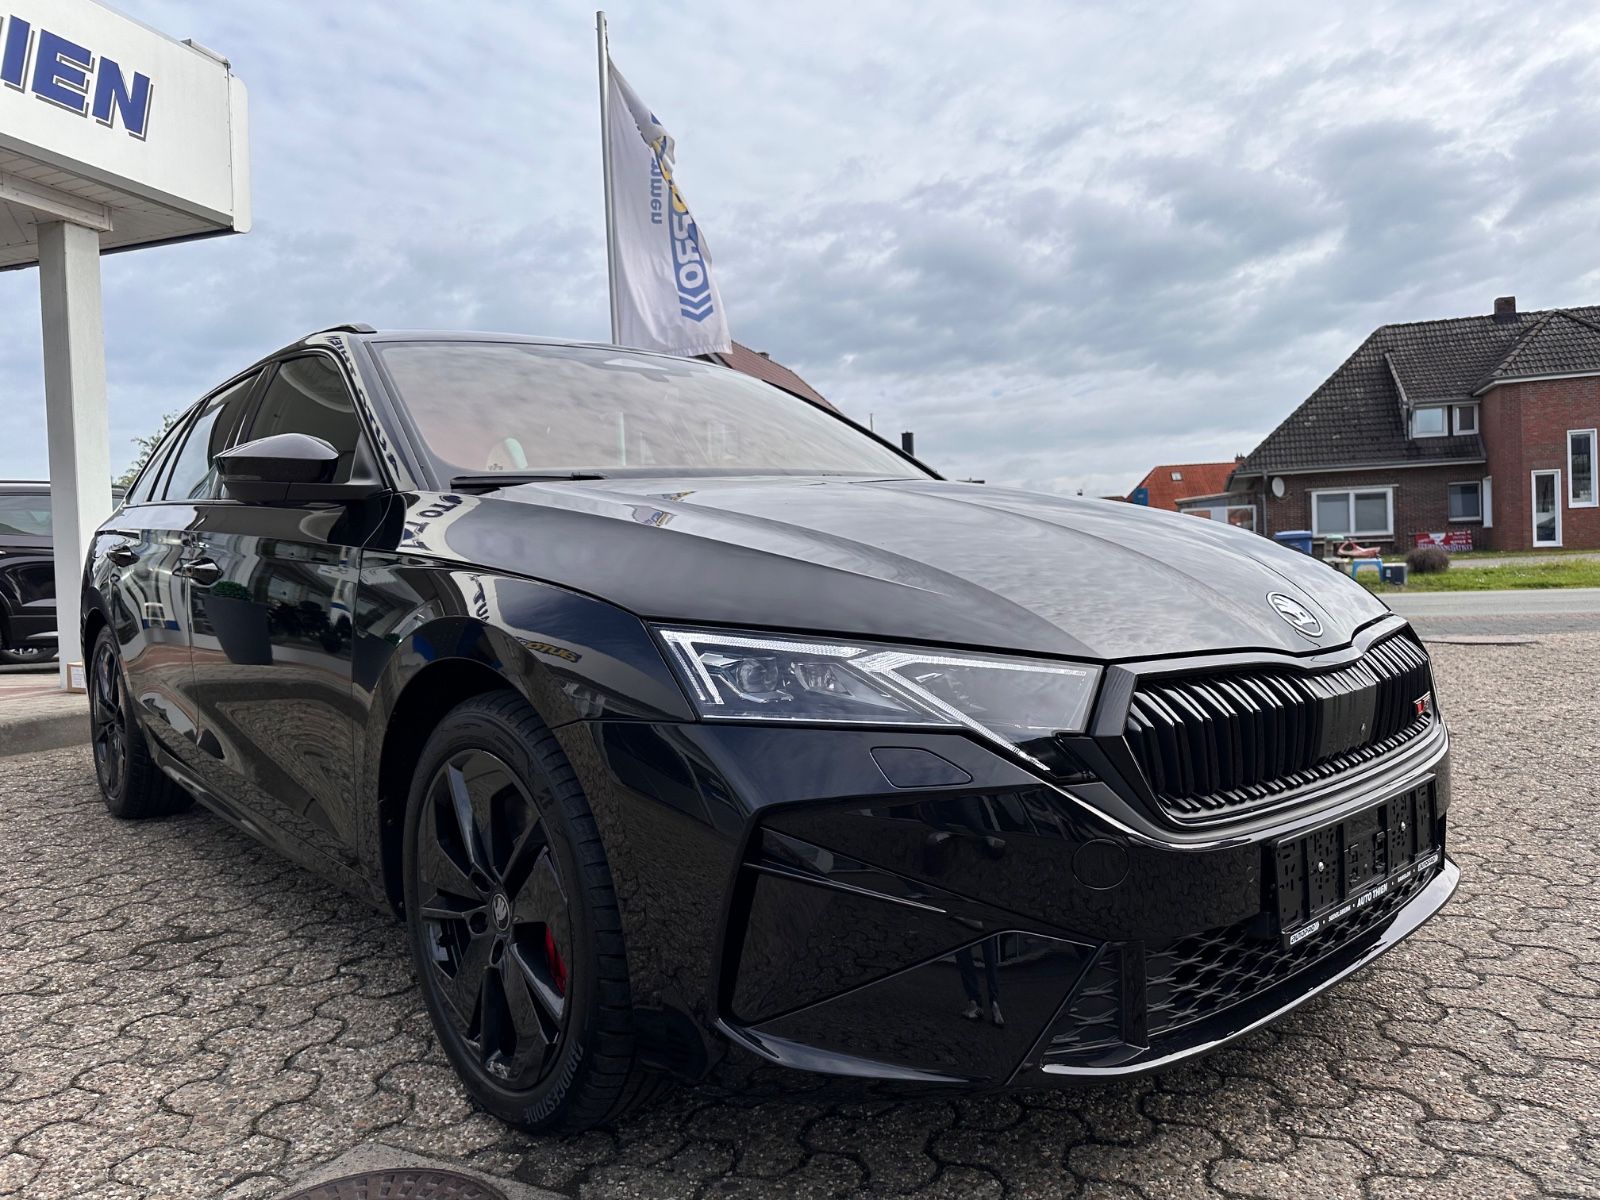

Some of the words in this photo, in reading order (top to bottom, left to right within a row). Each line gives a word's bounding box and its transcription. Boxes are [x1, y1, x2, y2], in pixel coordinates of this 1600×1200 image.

[0, 14, 154, 142] IEN
[1357, 891, 1372, 908] AUTO
[1373, 882, 1388, 899] THIEN
[524, 1040, 584, 1125] BRIDGESTONE
